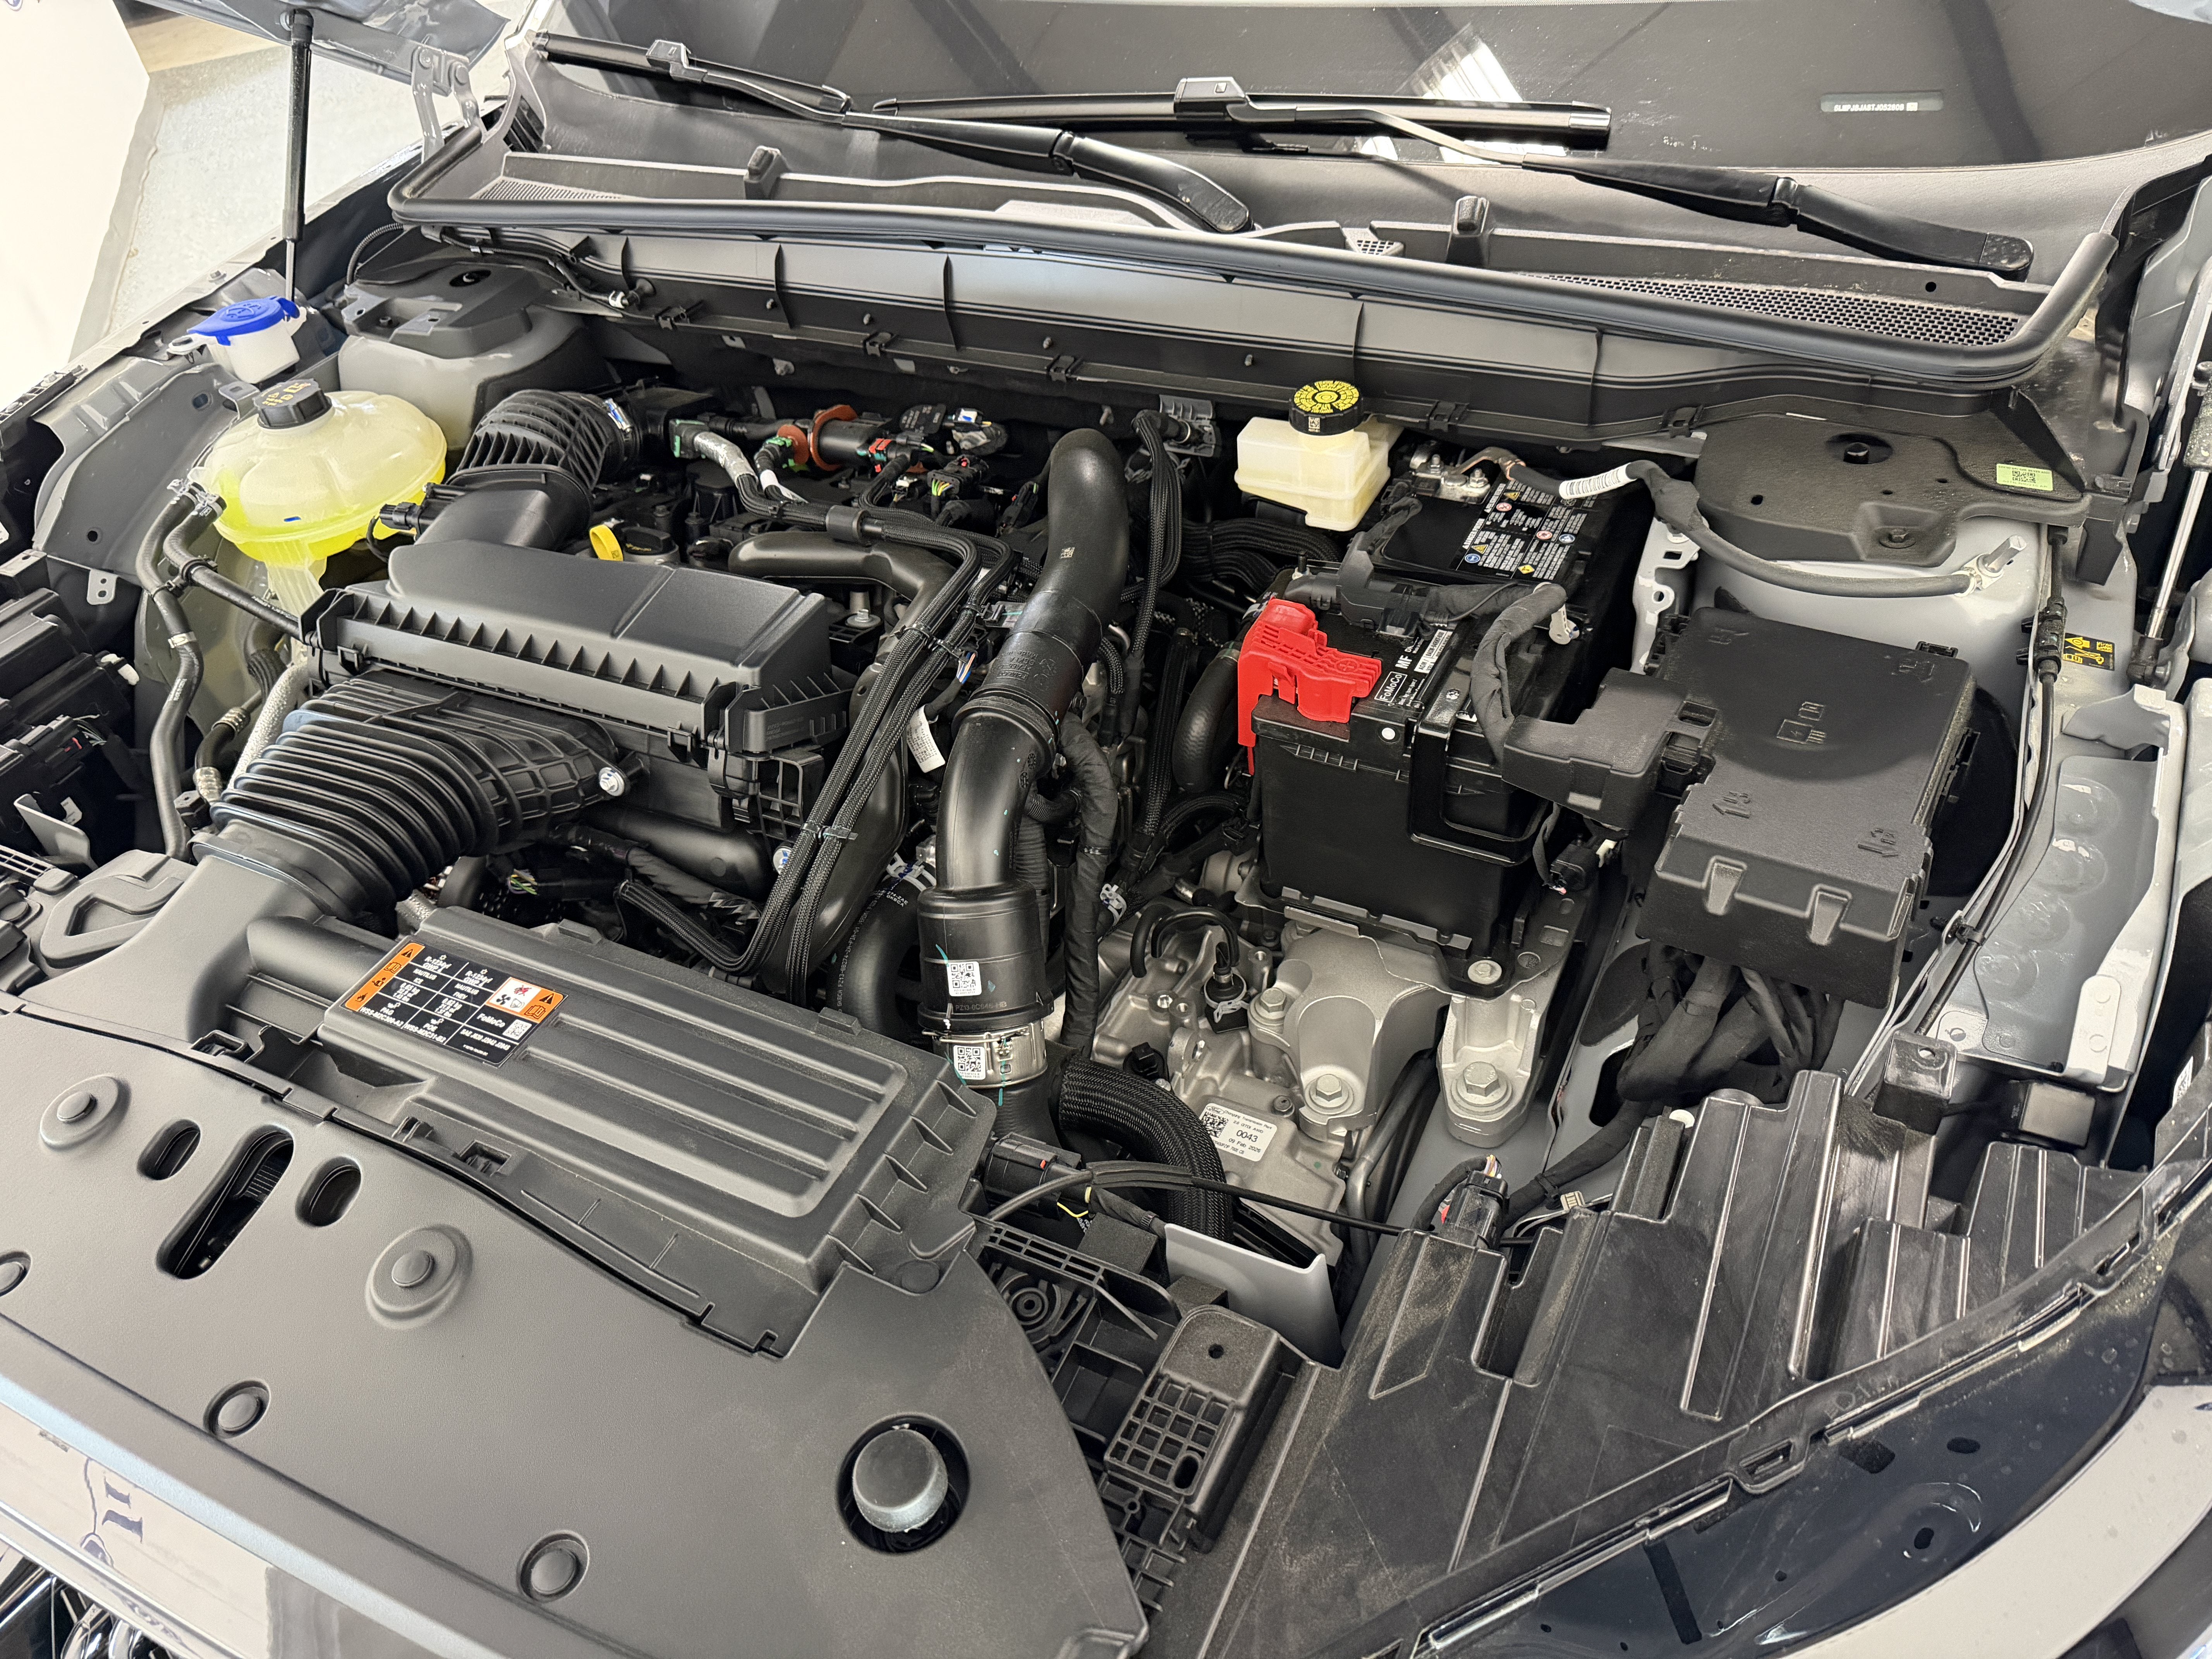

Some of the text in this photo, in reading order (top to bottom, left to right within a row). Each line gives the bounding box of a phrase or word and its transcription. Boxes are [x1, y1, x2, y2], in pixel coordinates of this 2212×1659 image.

[1395, 655, 1412, 669] MF
[1418, 661, 1427, 670] AGM
[1379, 674, 1402, 701] FoMoCo
[423, 963, 439, 972] GWP
[413, 969, 437, 980] NAUTILUS
[464, 977, 480, 986] GWP
[411, 987, 420, 995] kg
[454, 983, 479, 995] NAUTILUS
[453, 991, 468, 1000] FHEV
[453, 1002, 462, 1010] kg
[380, 1007, 394, 1015] PAG
[477, 1013, 505, 1028] FoMoCo
[423, 1023, 438, 1032] POE
[1242, 1116, 1263, 1126] Transmission
[1236, 1130, 1258, 1142] 0043
